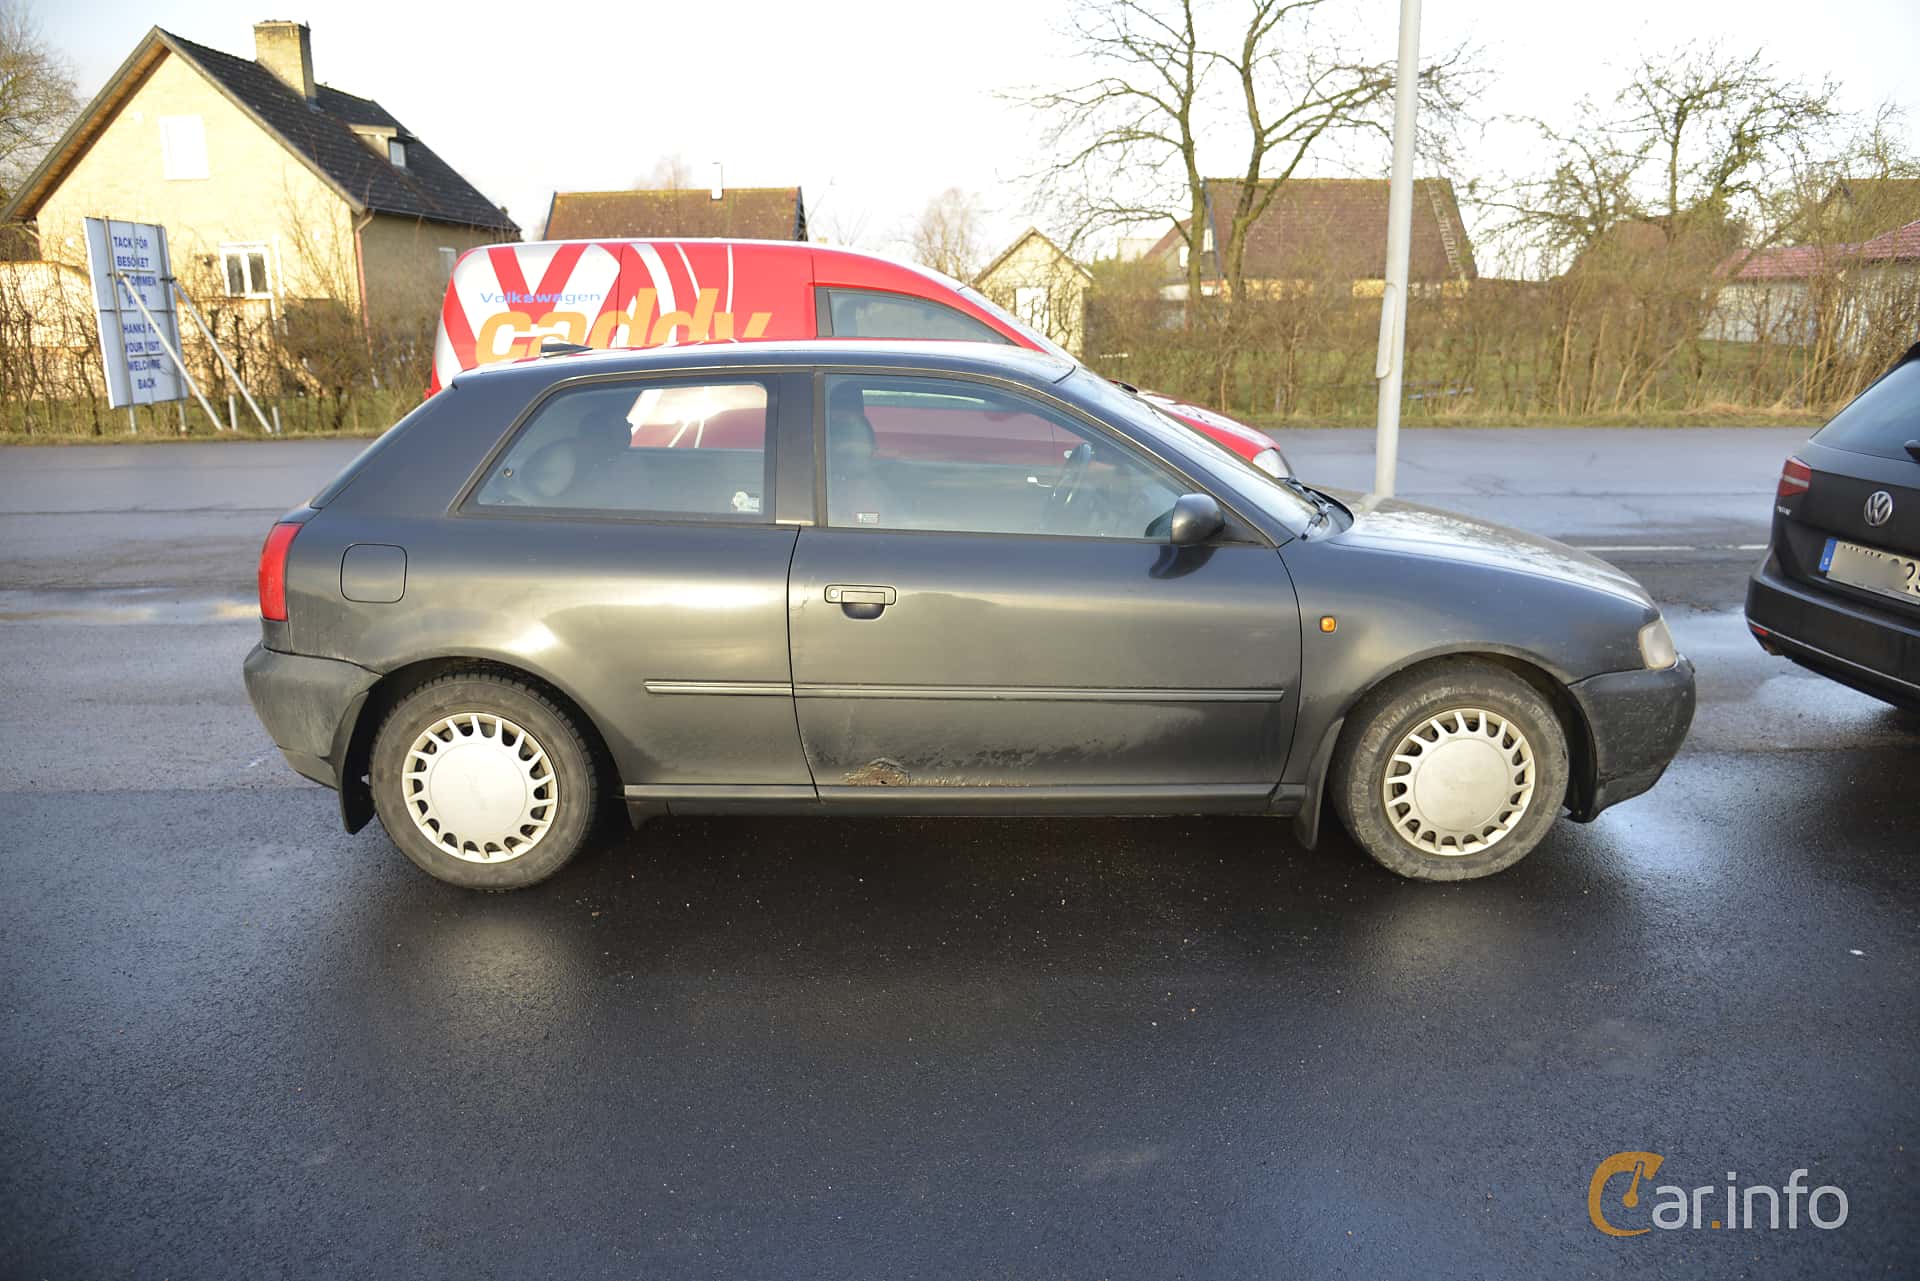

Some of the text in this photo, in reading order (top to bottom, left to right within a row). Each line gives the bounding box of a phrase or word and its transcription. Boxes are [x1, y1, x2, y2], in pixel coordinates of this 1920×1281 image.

[113, 235, 133, 248] TACK
[480, 290, 601, 305] Volkswagen
[122, 322, 146, 335] HANKS
[137, 377, 156, 390] BACK
